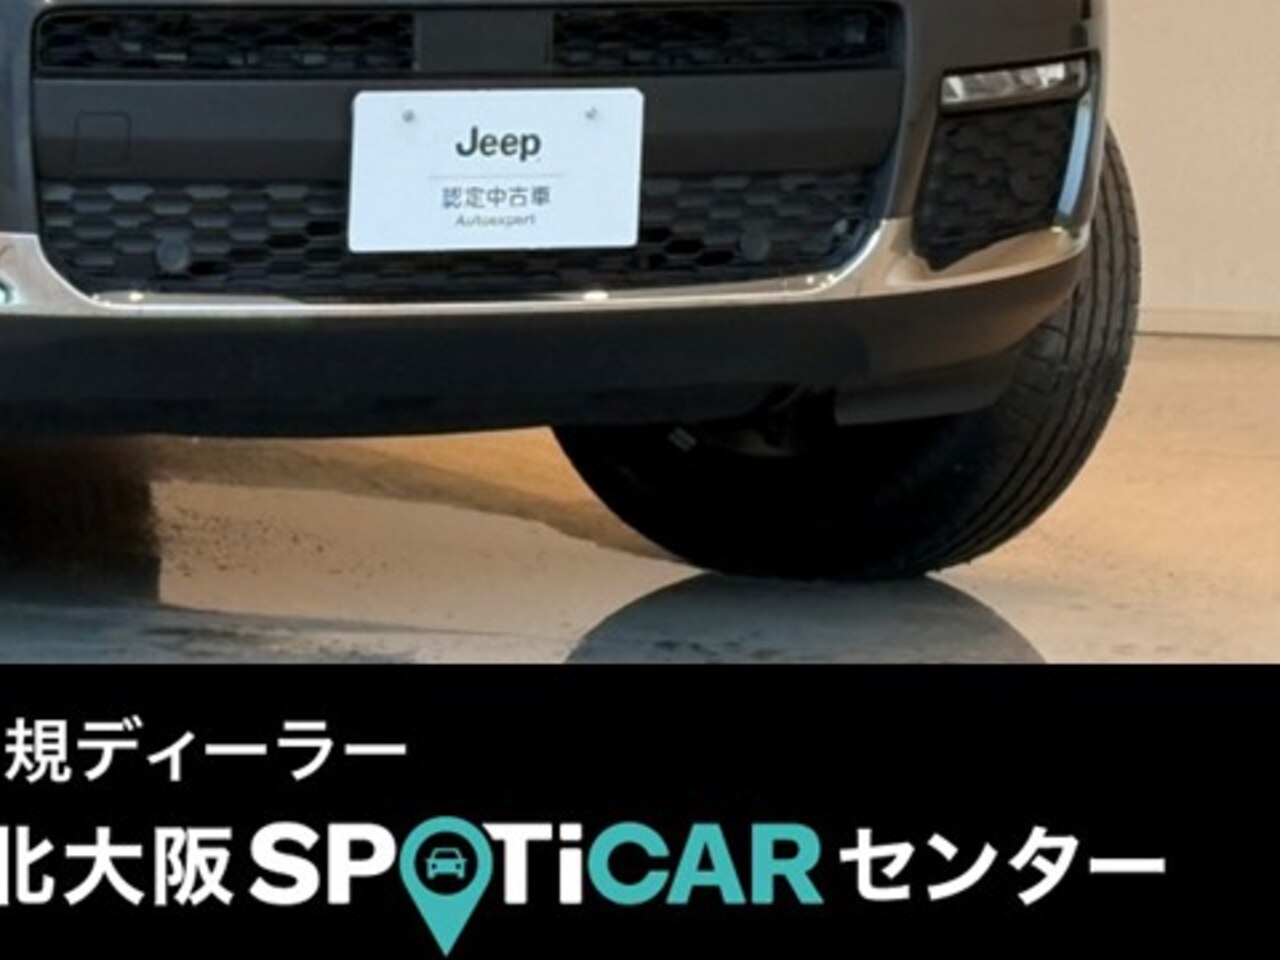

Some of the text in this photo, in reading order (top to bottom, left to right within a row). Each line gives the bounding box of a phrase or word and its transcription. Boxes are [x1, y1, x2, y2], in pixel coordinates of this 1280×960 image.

[455, 126, 541, 161] Jeep
[442, 186, 551, 209] 認定中古車
